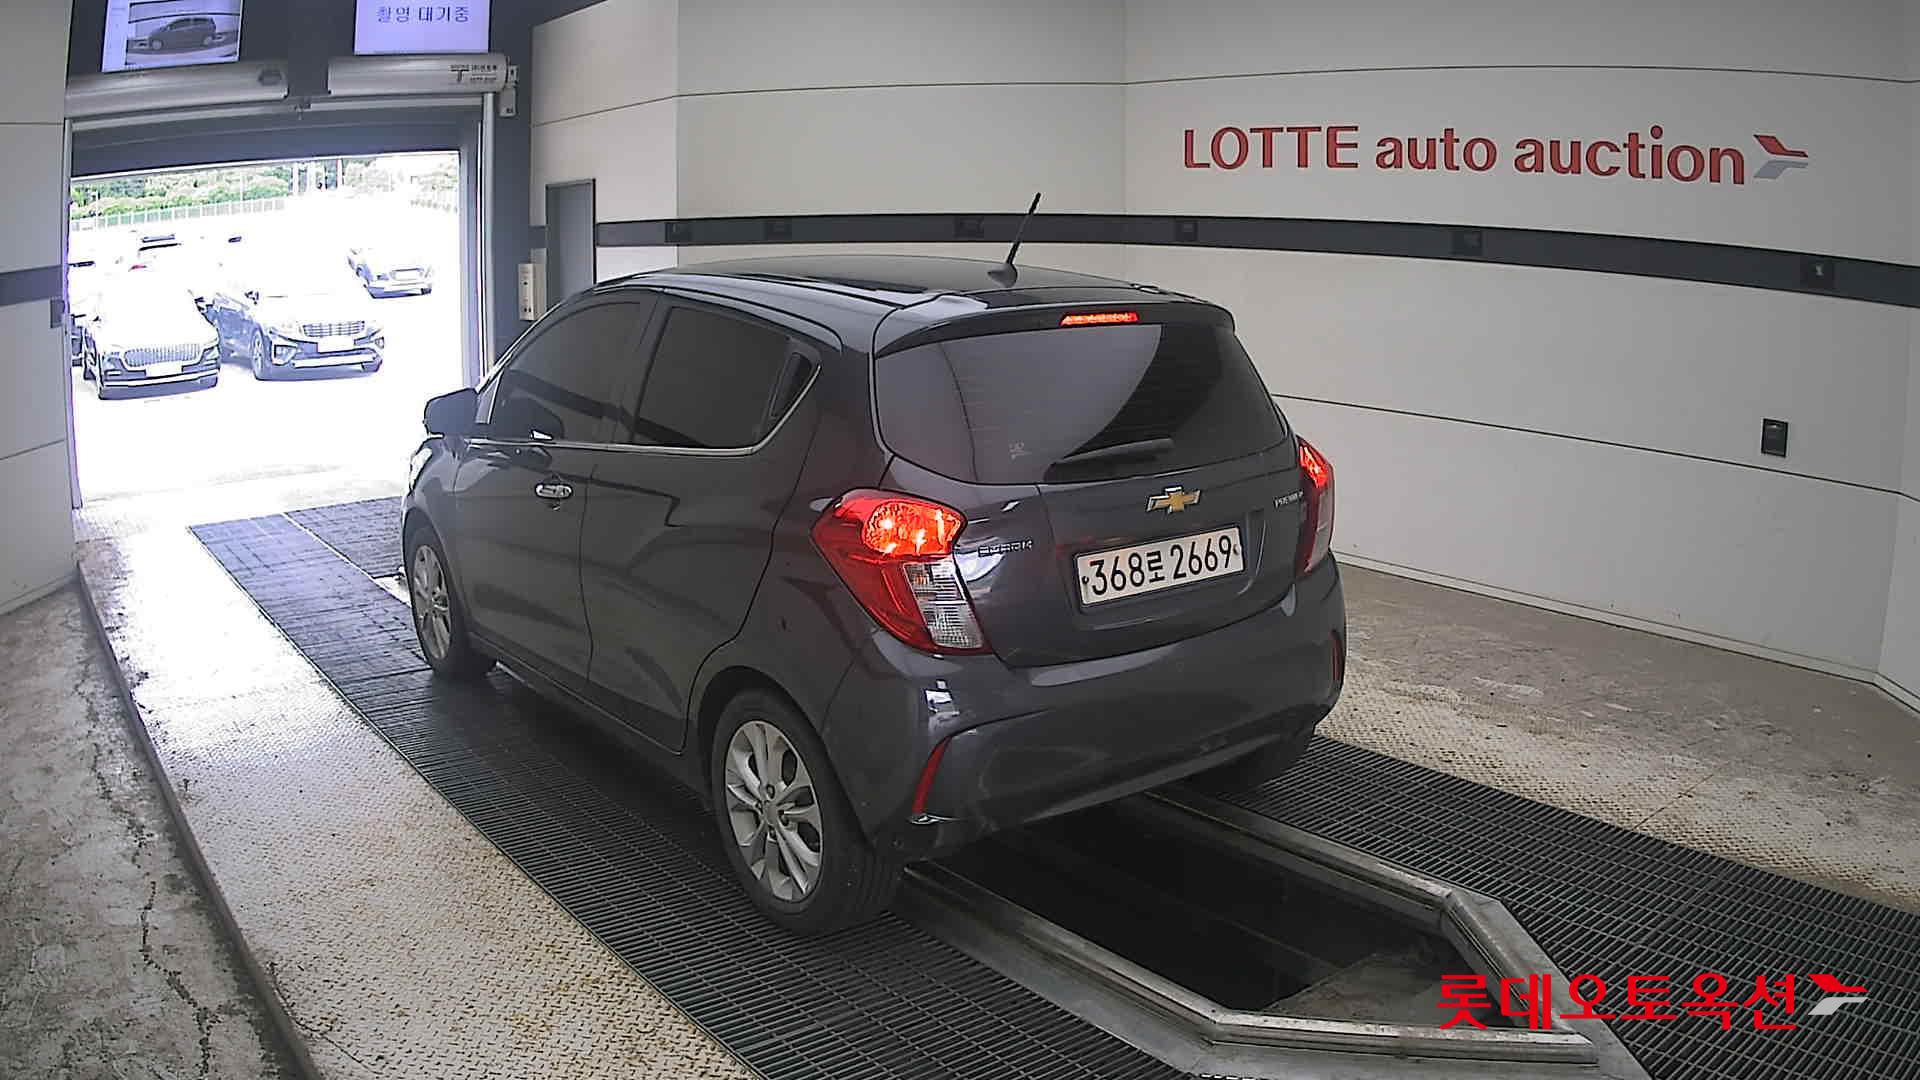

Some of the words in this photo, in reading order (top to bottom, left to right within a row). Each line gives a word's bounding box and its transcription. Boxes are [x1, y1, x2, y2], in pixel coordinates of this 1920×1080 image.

[418, 6, 469, 22] 대기중
[1184, 126, 1359, 169] LOTTE
[1375, 128, 1497, 171] auto
[1514, 125, 1745, 185] auction
[1089, 549, 1165, 596] 368로
[1169, 535, 1232, 580] 2669
